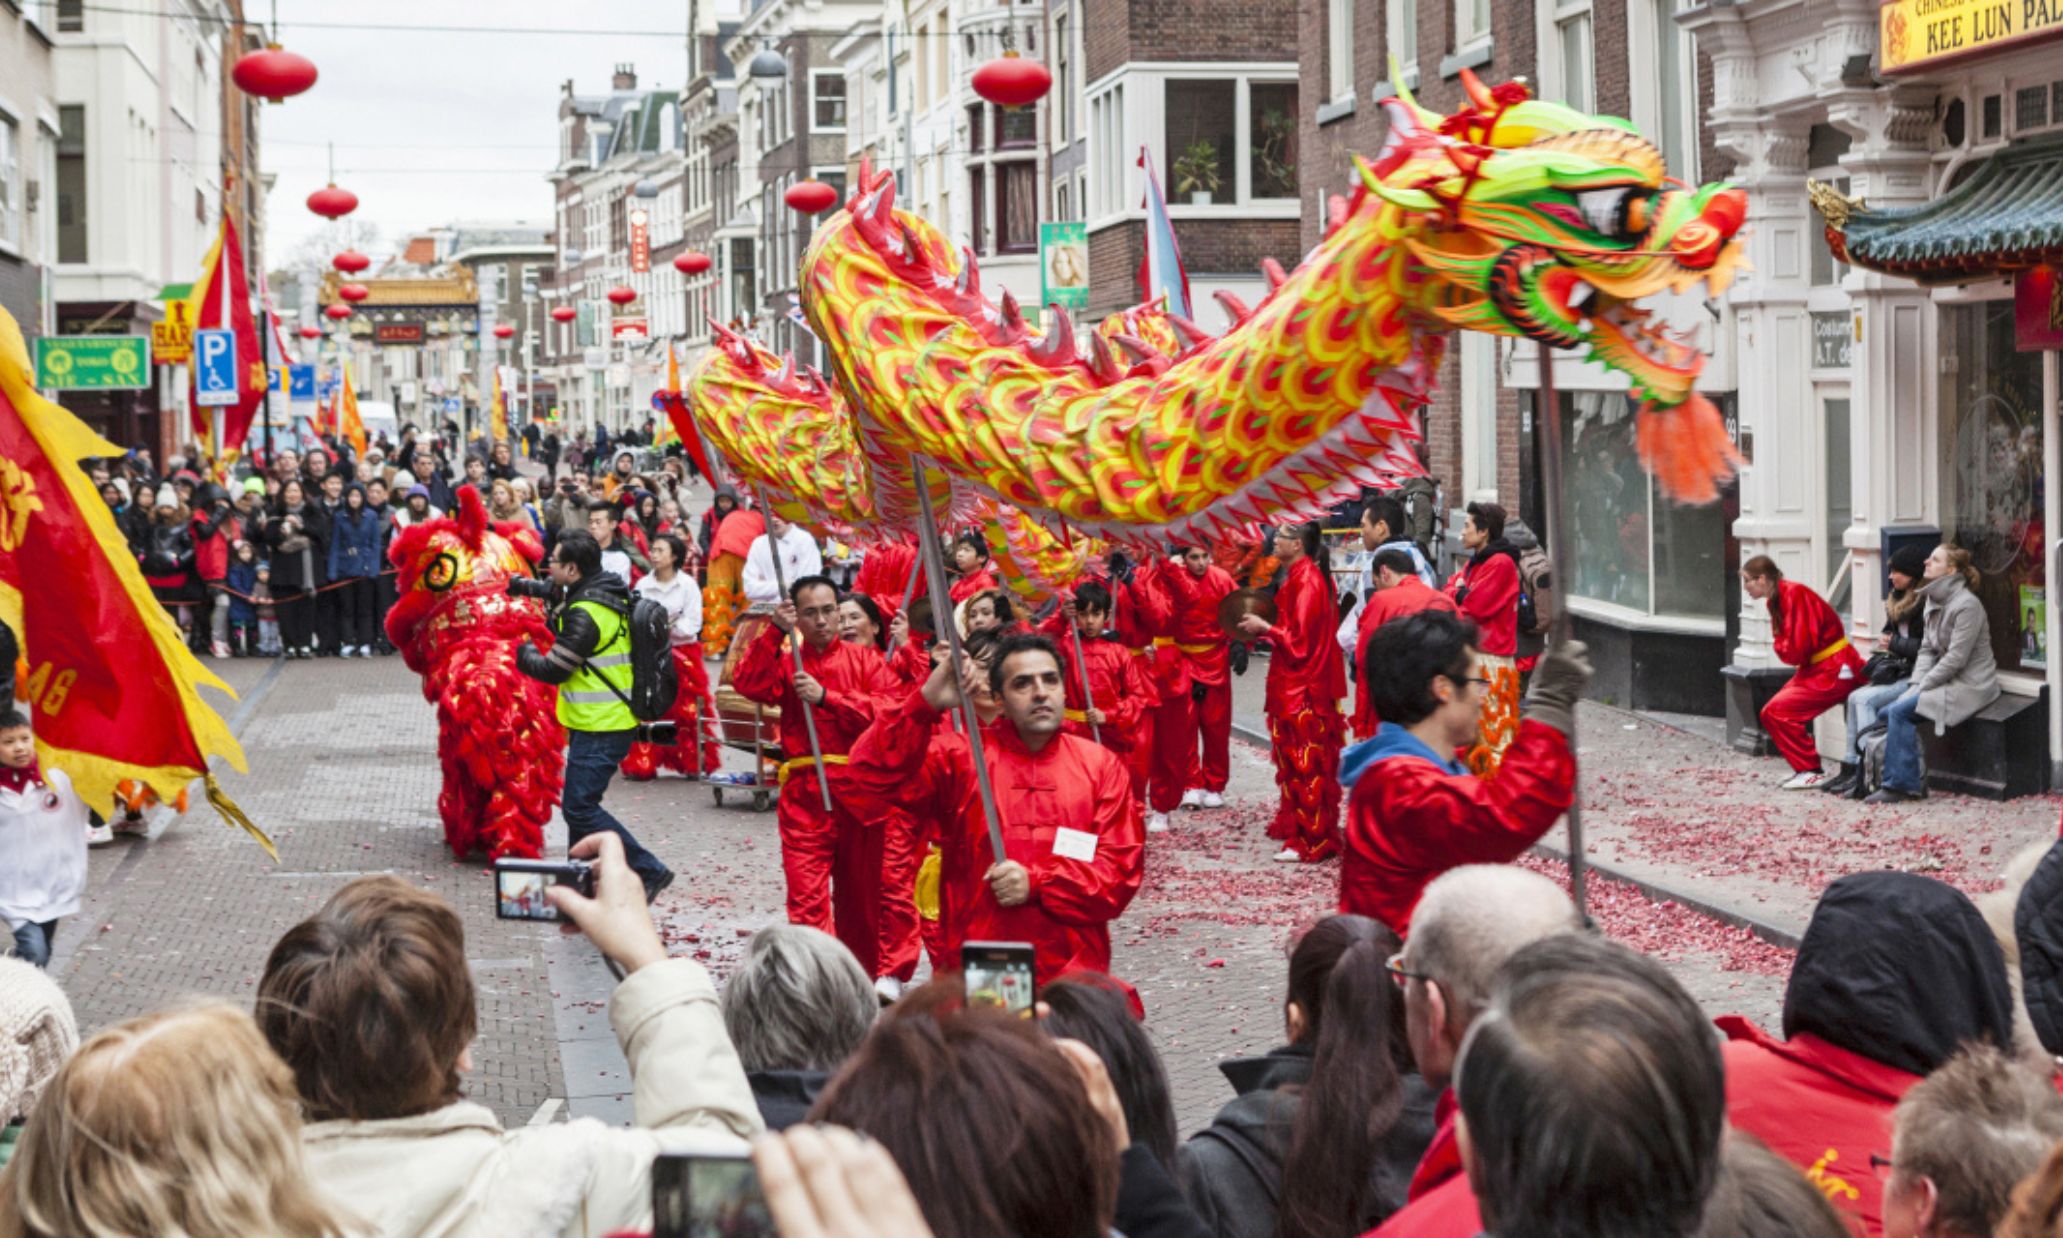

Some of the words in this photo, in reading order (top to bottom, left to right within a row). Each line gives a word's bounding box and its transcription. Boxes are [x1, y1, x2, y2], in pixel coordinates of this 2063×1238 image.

[1915, 0, 1963, 17] CHIN
[1926, 16, 1963, 54] KEE
[1973, 2, 2012, 43] LUN
[204, 335, 227, 368] P
